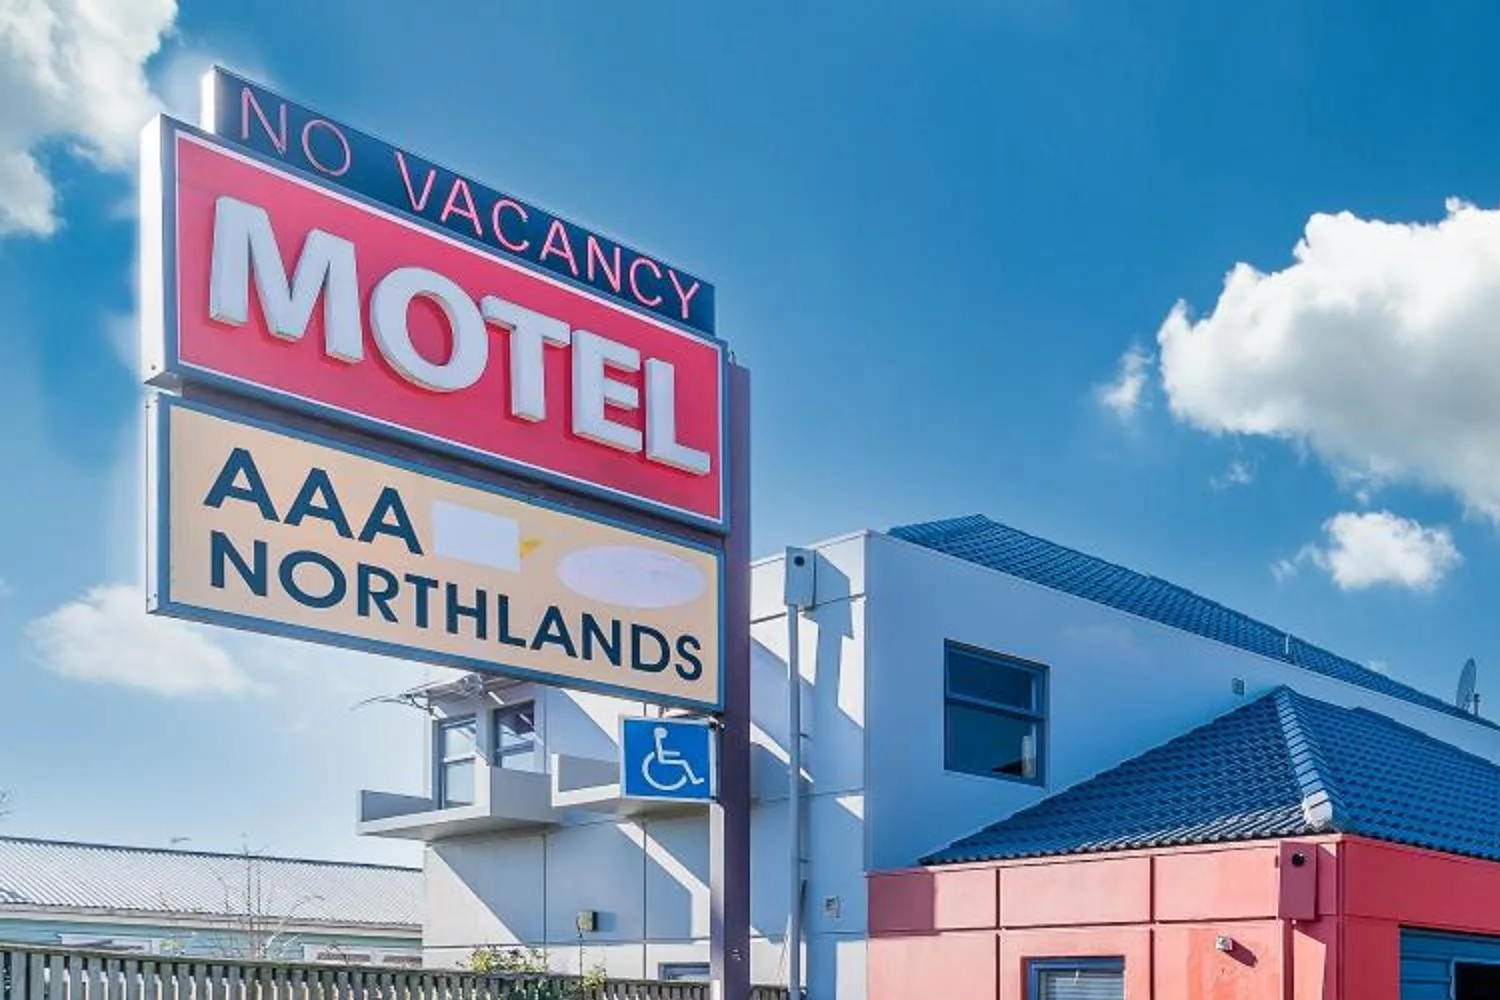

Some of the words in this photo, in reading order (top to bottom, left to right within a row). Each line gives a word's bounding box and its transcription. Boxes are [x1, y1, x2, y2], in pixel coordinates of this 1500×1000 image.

[240, 86, 351, 176] NO
[396, 150, 700, 319] VACANCY
[209, 195, 711, 475] MOTEL
[203, 447, 424, 555] AAA
[210, 530, 704, 681] NORTHLANDS
